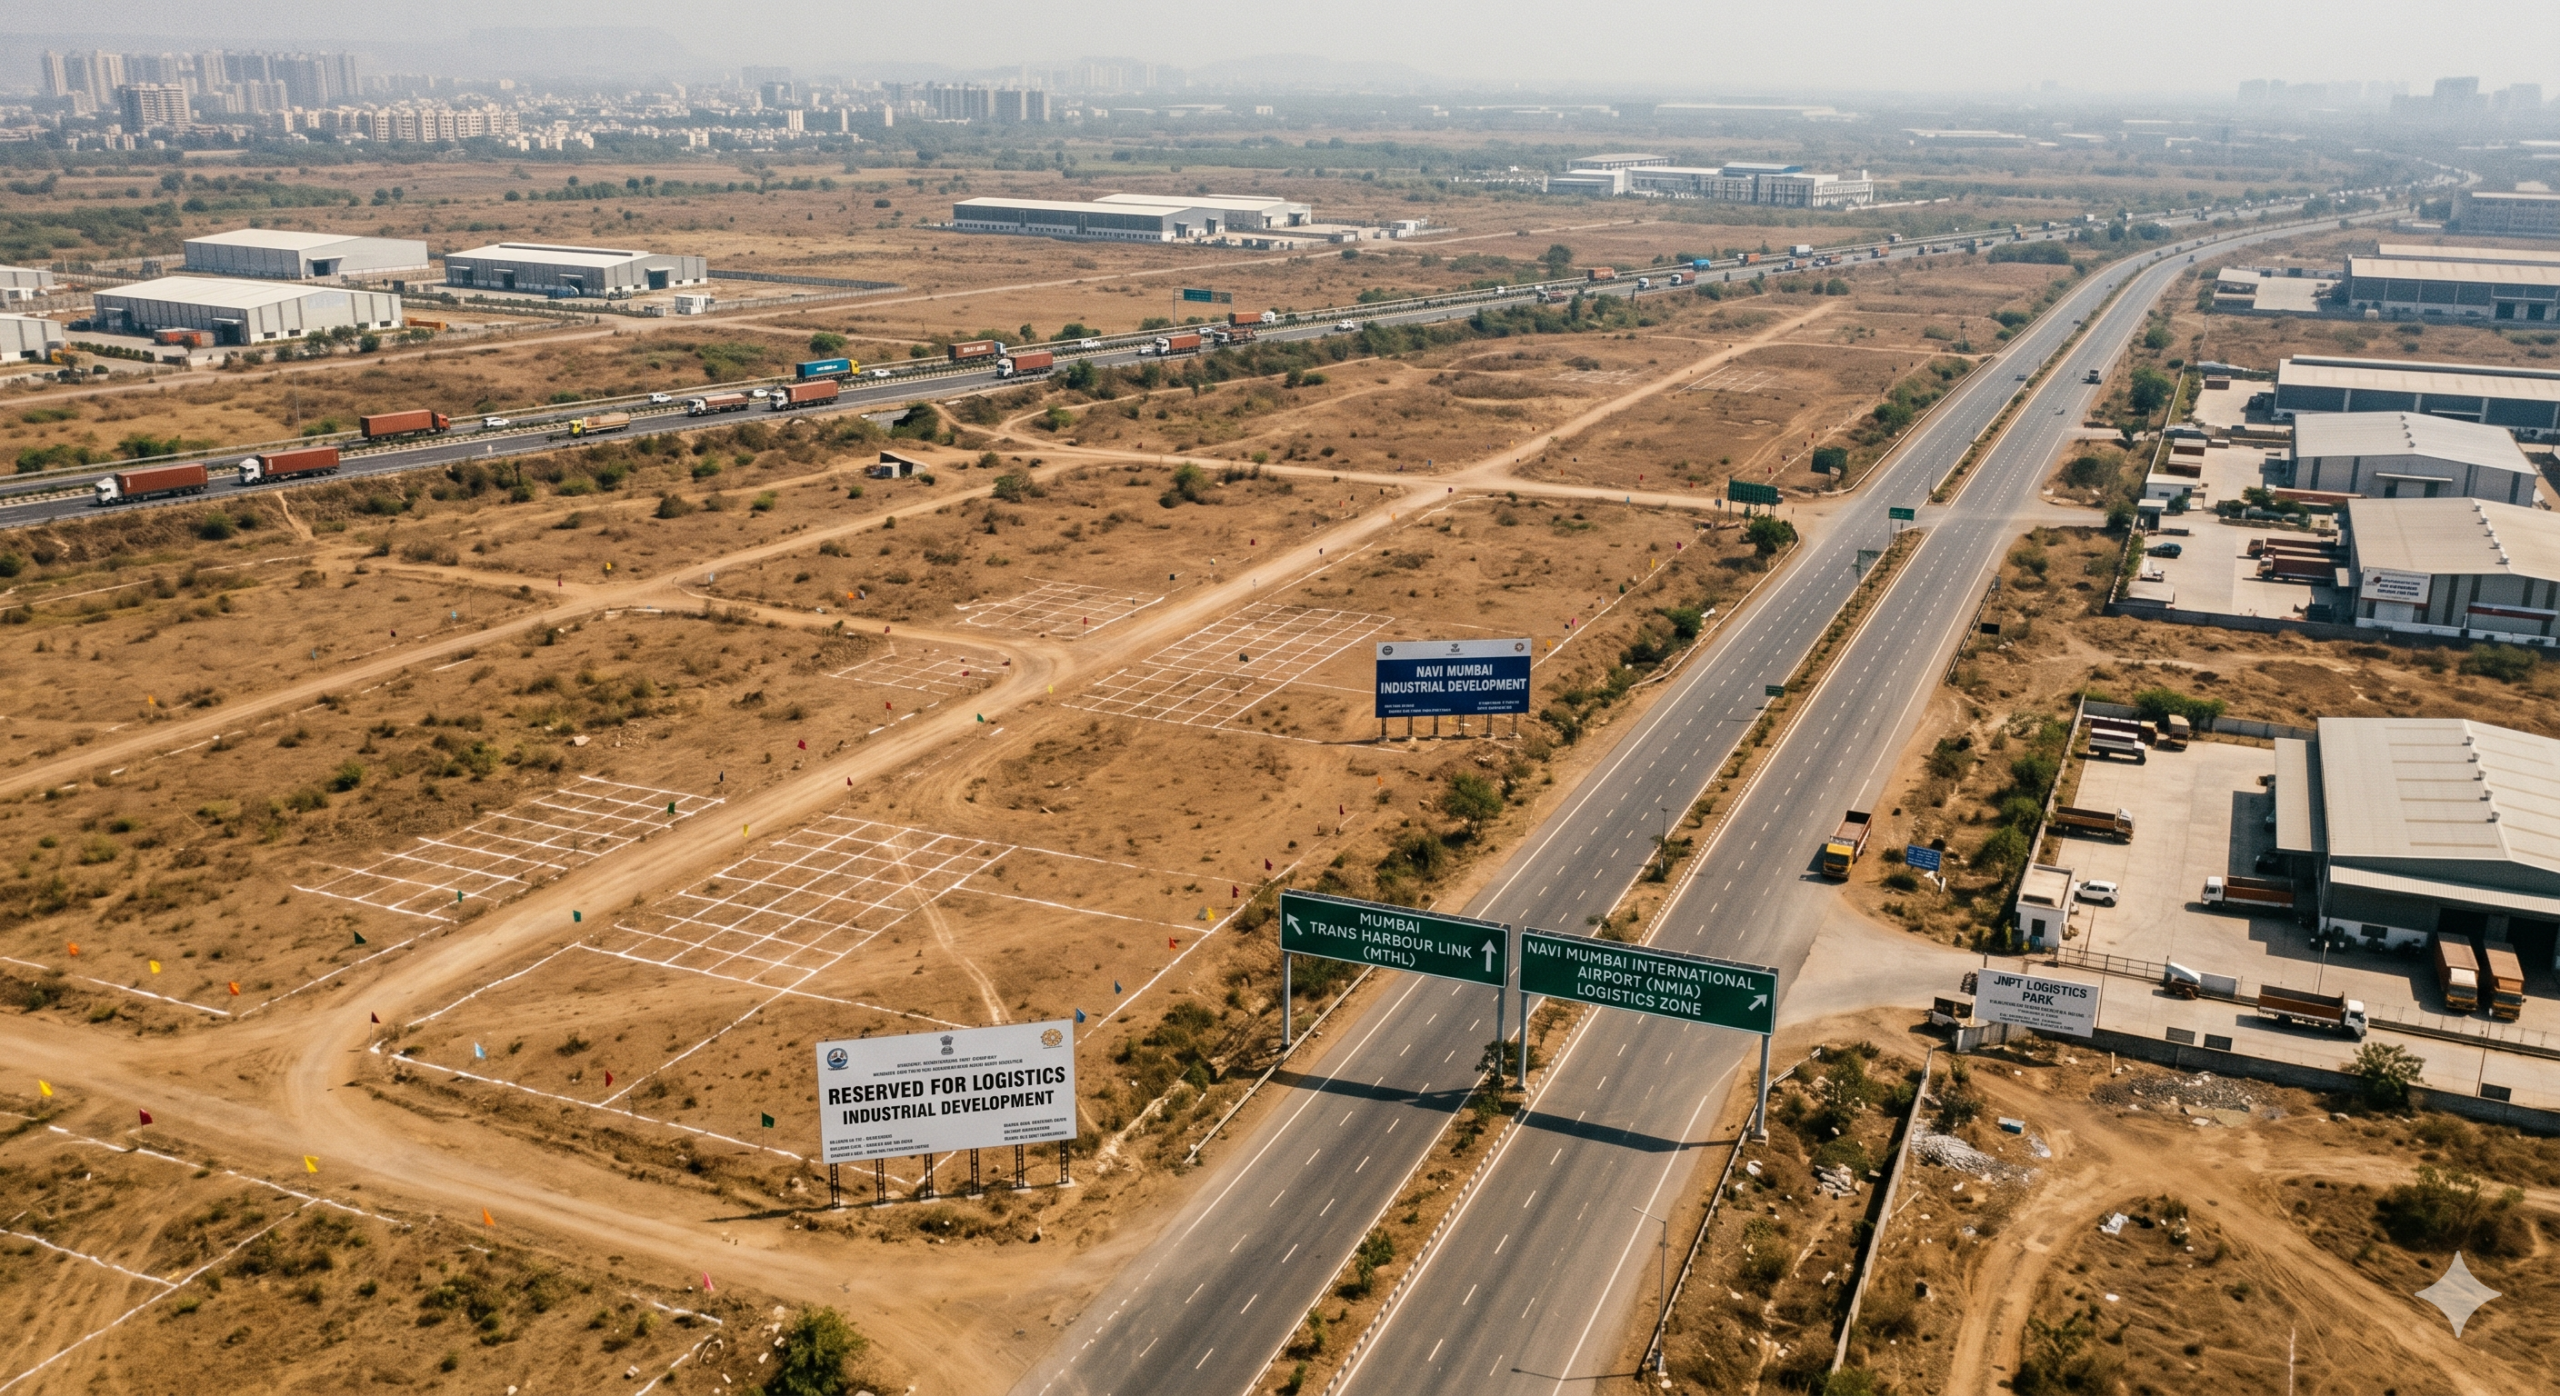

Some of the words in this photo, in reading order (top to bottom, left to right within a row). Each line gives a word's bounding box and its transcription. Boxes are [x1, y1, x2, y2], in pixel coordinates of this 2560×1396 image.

[1416, 665, 1443, 678] NAVI
[1446, 664, 1493, 677] MUMBAI
[1380, 680, 1446, 694] INDUSTRIAL
[1447, 678, 1527, 693] DEVELOPMENT
[1360, 912, 1421, 934] MUMBAI
[1309, 920, 1357, 940] TRANS
[1361, 931, 1434, 952] HARBOUR
[1438, 941, 1472, 959] LINK
[1363, 945, 1416, 967] (MTHL)
[1527, 941, 1561, 958] NAVI
[1566, 947, 1627, 969] MUMBAI
[1632, 958, 1756, 991] INTERNATIONAL
[1577, 966, 1642, 988] AIRPORT
[1646, 977, 1701, 1000] (NMIA)
[1993, 975, 2024, 989] JNPT
[2026, 980, 2088, 999] LOGISTICS
[1577, 982, 1655, 1007] LOGISTICS
[1659, 997, 1702, 1016] ZONE
[2022, 991, 2054, 1006] PARK
[828, 1079, 924, 1105] RESERVED
[931, 1075, 967, 1096] FOR
[973, 1066, 1066, 1092] LOGISTICS
[843, 1102, 936, 1125] INDUSTRIAL
[941, 1089, 1054, 1115] DEVELOPMENT
